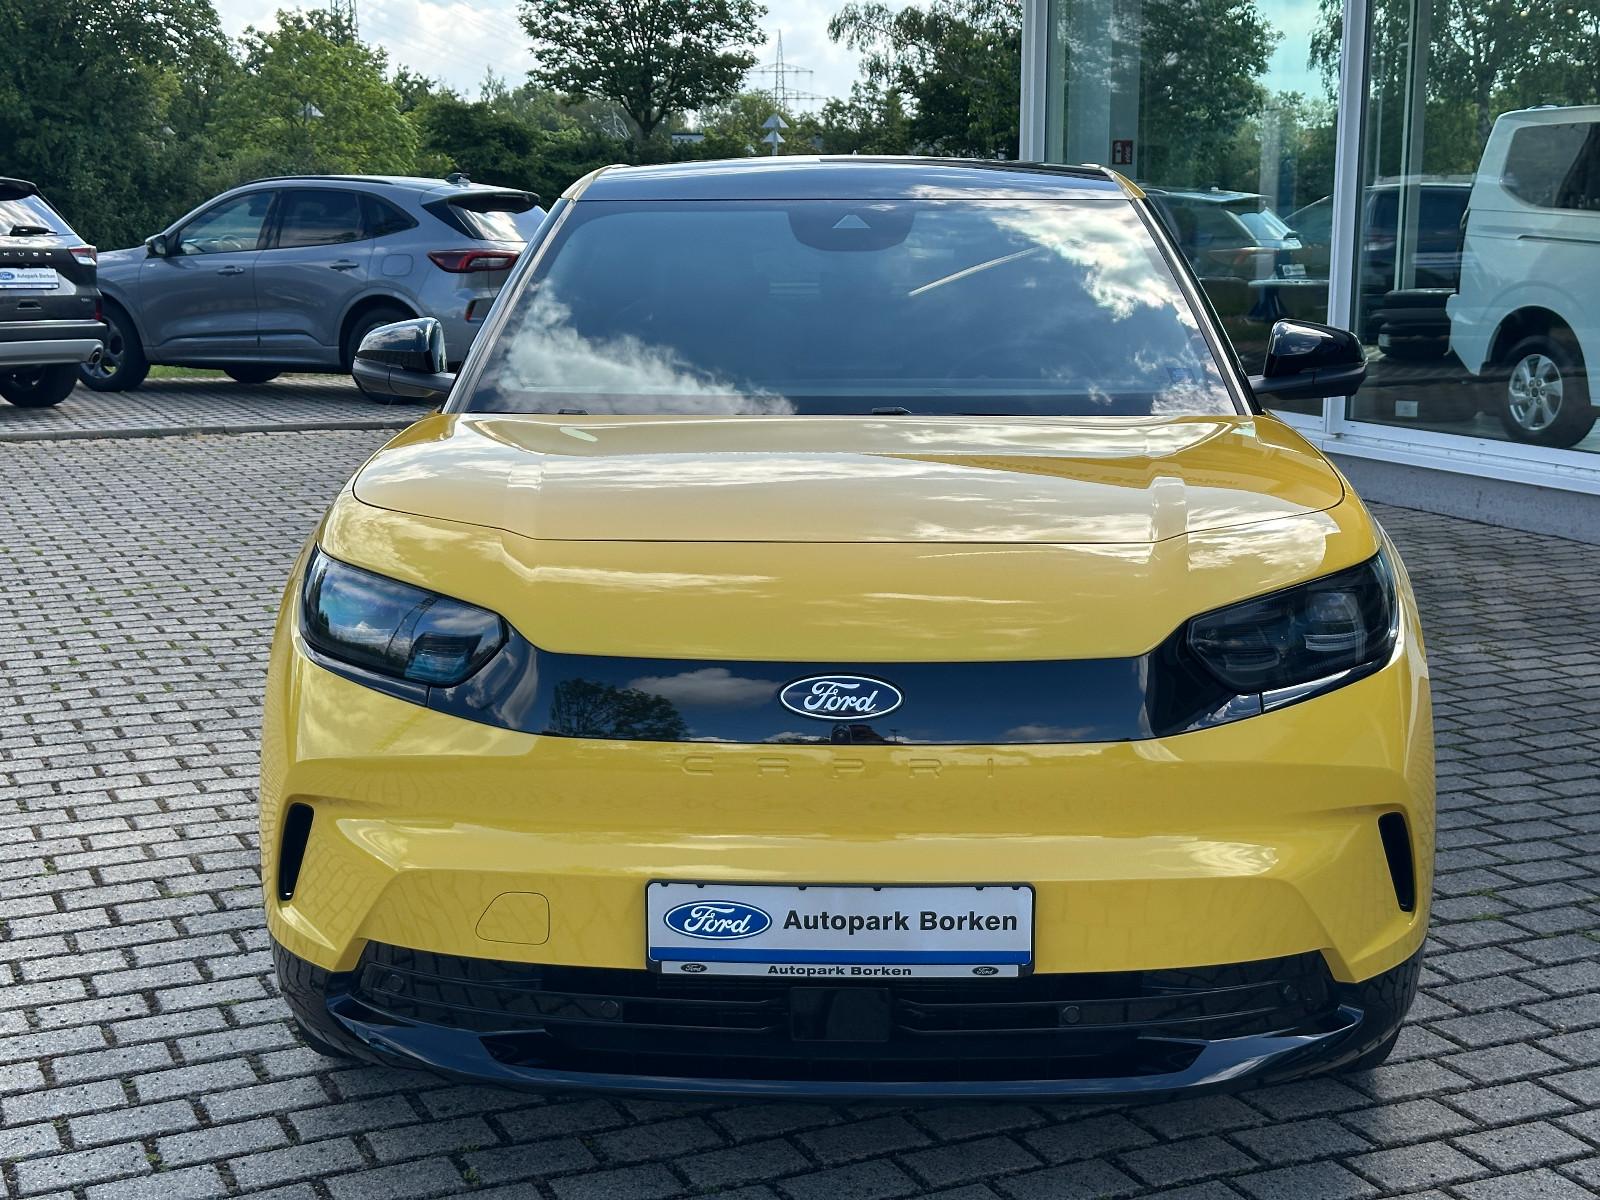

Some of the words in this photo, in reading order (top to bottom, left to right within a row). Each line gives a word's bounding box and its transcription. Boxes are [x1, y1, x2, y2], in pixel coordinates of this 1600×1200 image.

[803, 681, 879, 712] Ford
[681, 755, 994, 778] CAPRI
[683, 905, 752, 934] Ford
[783, 910, 910, 936] Autopark
[919, 911, 1018, 931] Borken
[767, 965, 846, 977] Autopark
[850, 966, 912, 976] Borken
